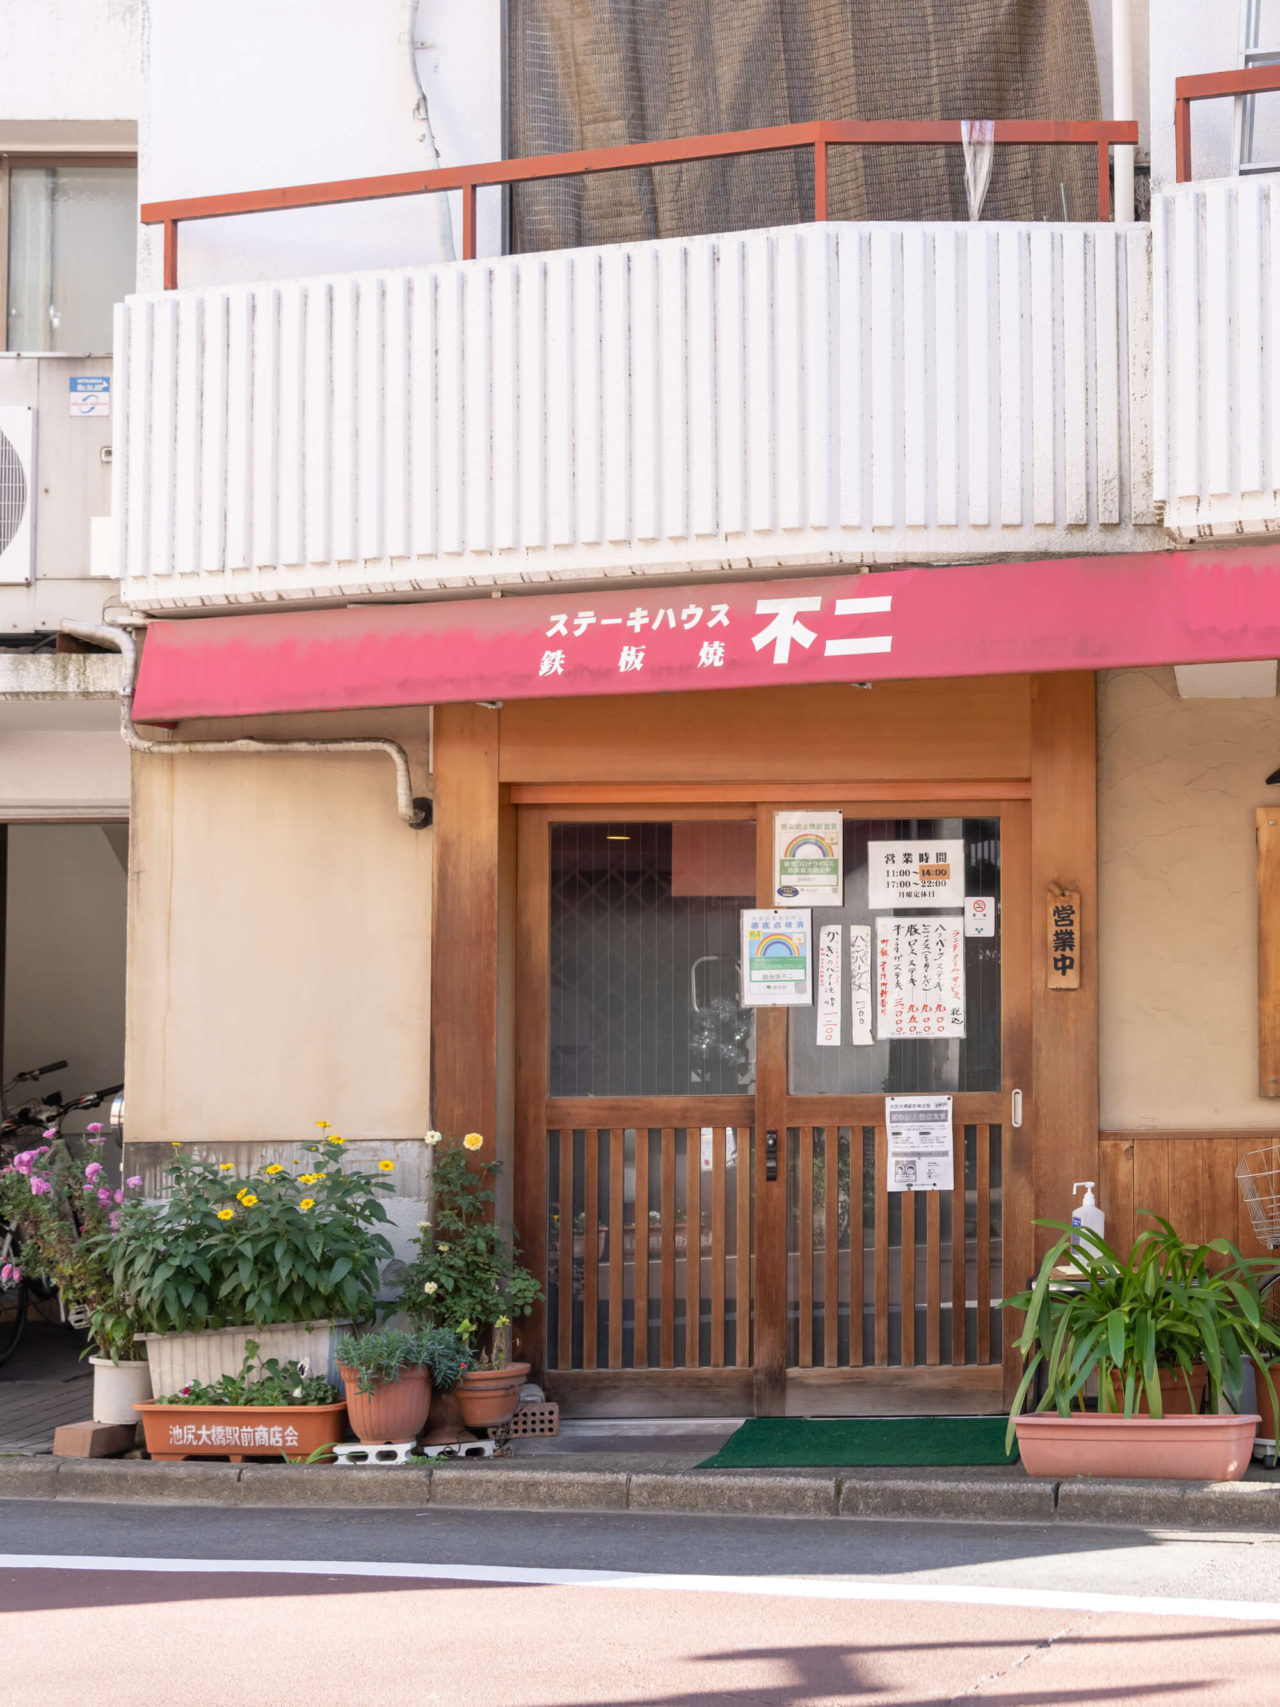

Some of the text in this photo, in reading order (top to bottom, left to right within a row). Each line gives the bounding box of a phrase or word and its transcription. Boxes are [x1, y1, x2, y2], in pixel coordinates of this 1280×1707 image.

[545, 603, 730, 637] ステーキハウス
[751, 595, 893, 664] 不二
[538, 640, 726, 677] 鉄板焼
[884, 852, 947, 864] 営業時間
[898, 890, 935, 898] 月曜定休日
[1053, 904, 1076, 976] 営業中
[169, 1425, 299, 1447] 池尻大橋駅前商店会
